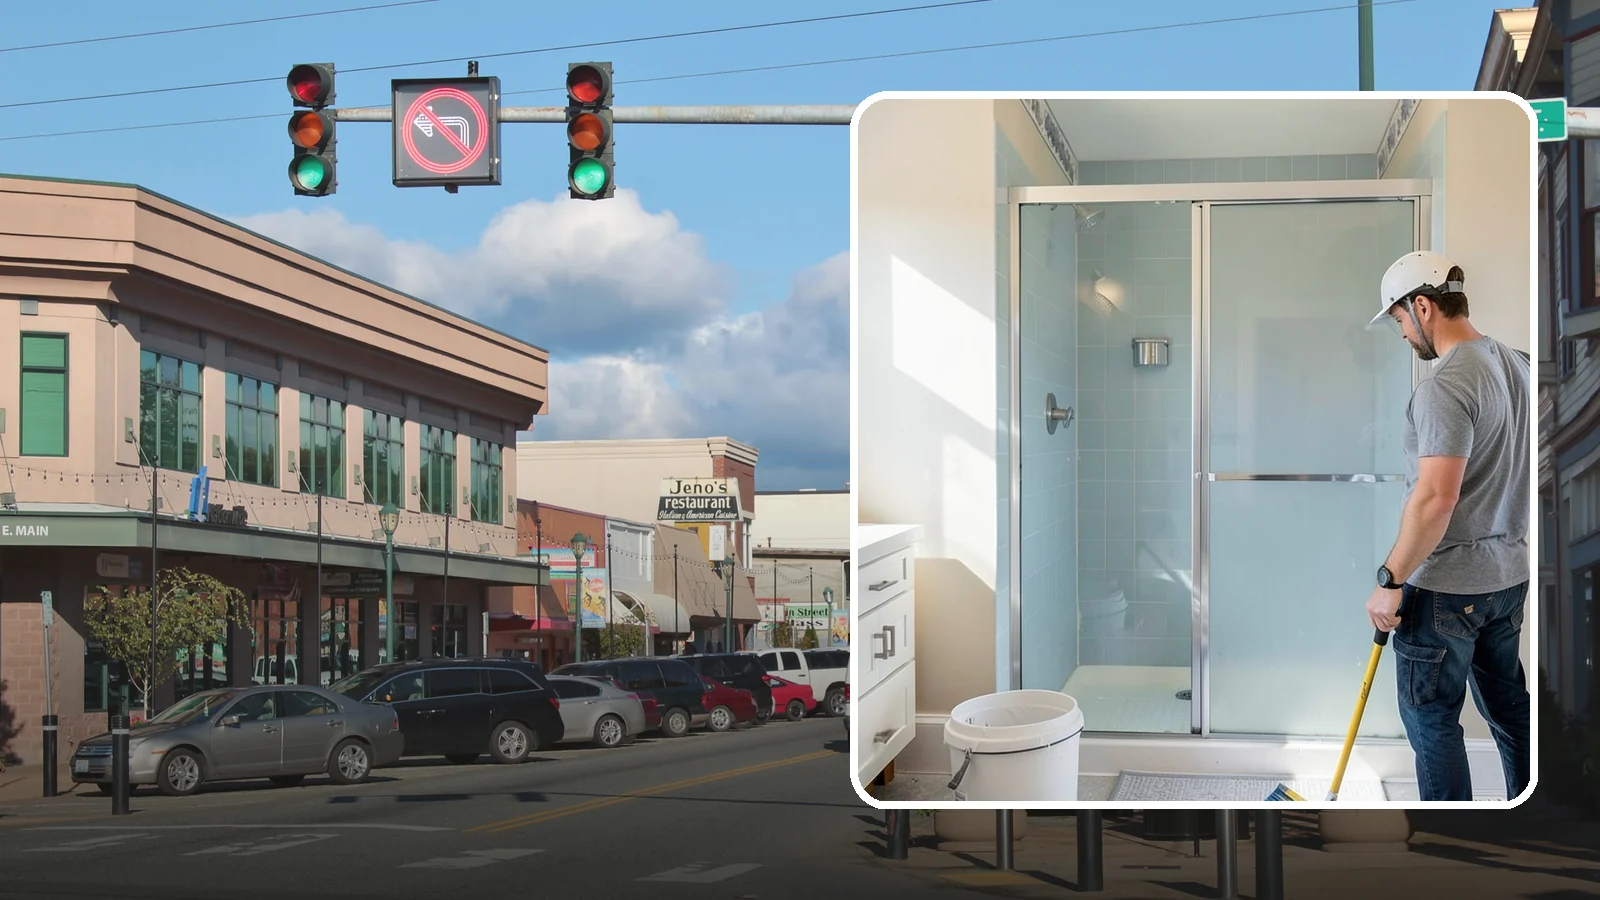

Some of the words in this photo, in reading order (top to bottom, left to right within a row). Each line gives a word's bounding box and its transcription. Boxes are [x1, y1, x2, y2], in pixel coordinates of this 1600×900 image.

[670, 480, 728, 494] Jeno's
[665, 496, 731, 509] restaurant
[658, 510, 681, 519] Italian
[686, 510, 714, 519] American
[715, 510, 737, 519] Cuisine
[2, 525, 13, 536] E.
[16, 525, 48, 536] MAIN
[786, 608, 795, 616] in
[798, 608, 828, 616] Street
